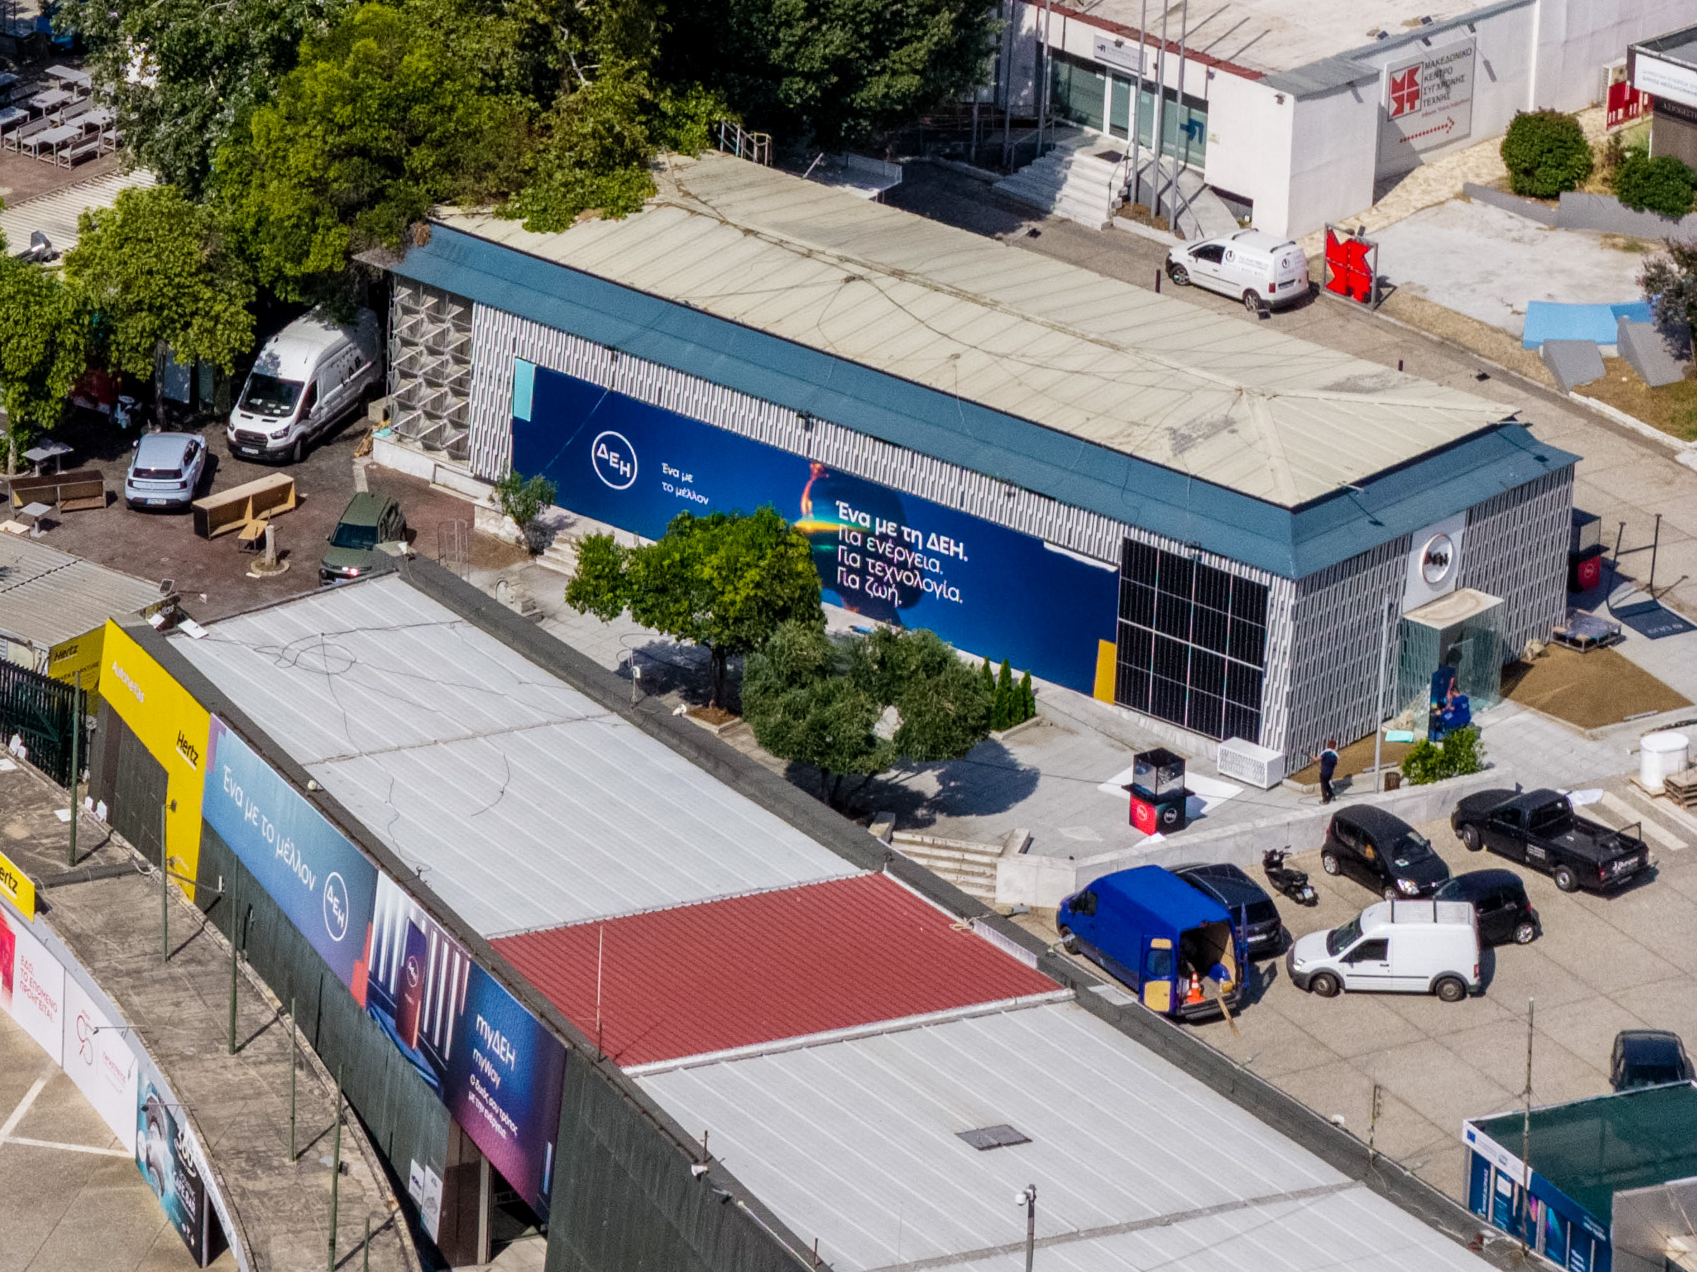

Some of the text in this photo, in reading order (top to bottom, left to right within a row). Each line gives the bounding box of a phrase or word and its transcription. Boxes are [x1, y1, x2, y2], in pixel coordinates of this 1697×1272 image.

[1424, 47, 1472, 70] ΜΑΚΕΔΟΝΙΚΟ
[596, 443, 631, 478] ΔΕΗ
[662, 462, 694, 484] Ένα με
[662, 481, 709, 506] το μέλλον
[835, 500, 969, 563] Ένα με τη ΔΕΗ.
[838, 524, 943, 576] Για ενέργεια.
[837, 544, 964, 604] Για τεχνολογία.
[837, 566, 902, 606] Για ζωή.
[55, 646, 79, 661] Hertz
[176, 730, 199, 766] Hertz
[223, 764, 317, 892] Ένα με το μέλλον
[325, 884, 346, 929] ΔΕΗ
[30, 974, 59, 1015] ΕΠΟΜΕΝΟ
[475, 1012, 517, 1072] myΔΕΗ
[472, 1047, 502, 1090] myWay
